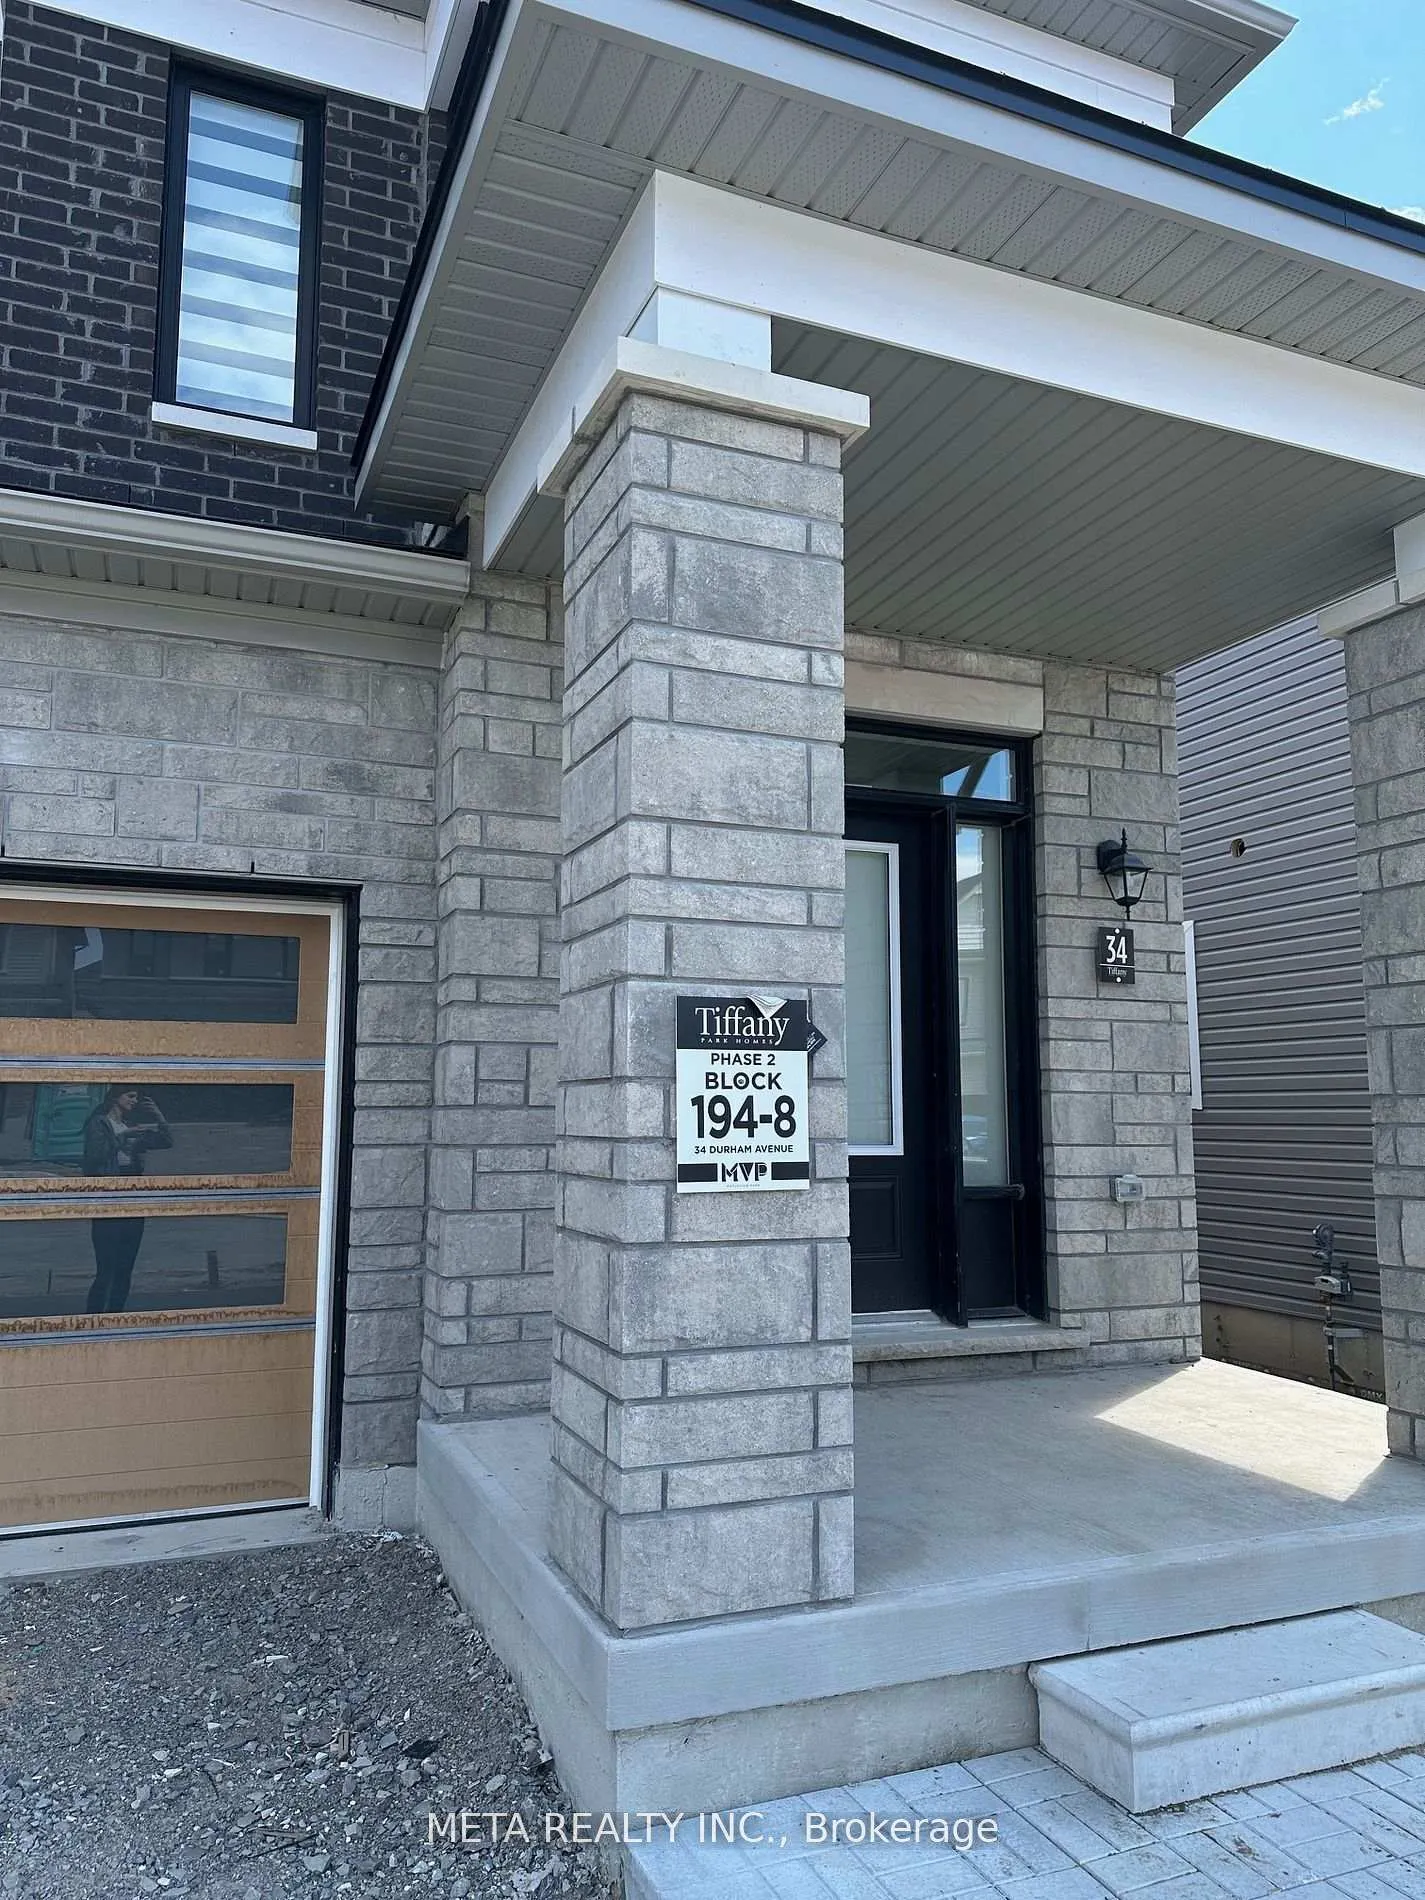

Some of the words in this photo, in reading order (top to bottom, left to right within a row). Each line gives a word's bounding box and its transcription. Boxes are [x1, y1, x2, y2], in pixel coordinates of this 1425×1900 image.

[1106, 935, 1128, 964] 34
[695, 1006, 790, 1046] Tiffany
[711, 1053, 762, 1066] PHASE
[767, 1054, 776, 1066] 2
[705, 1072, 782, 1090] BLOCK
[690, 1095, 797, 1139] 194-8
[694, 1146, 706, 1154] 34
[709, 1145, 752, 1154] DURHAM
[755, 1144, 794, 1153] AVENUE
[721, 1162, 768, 1182] MVP
